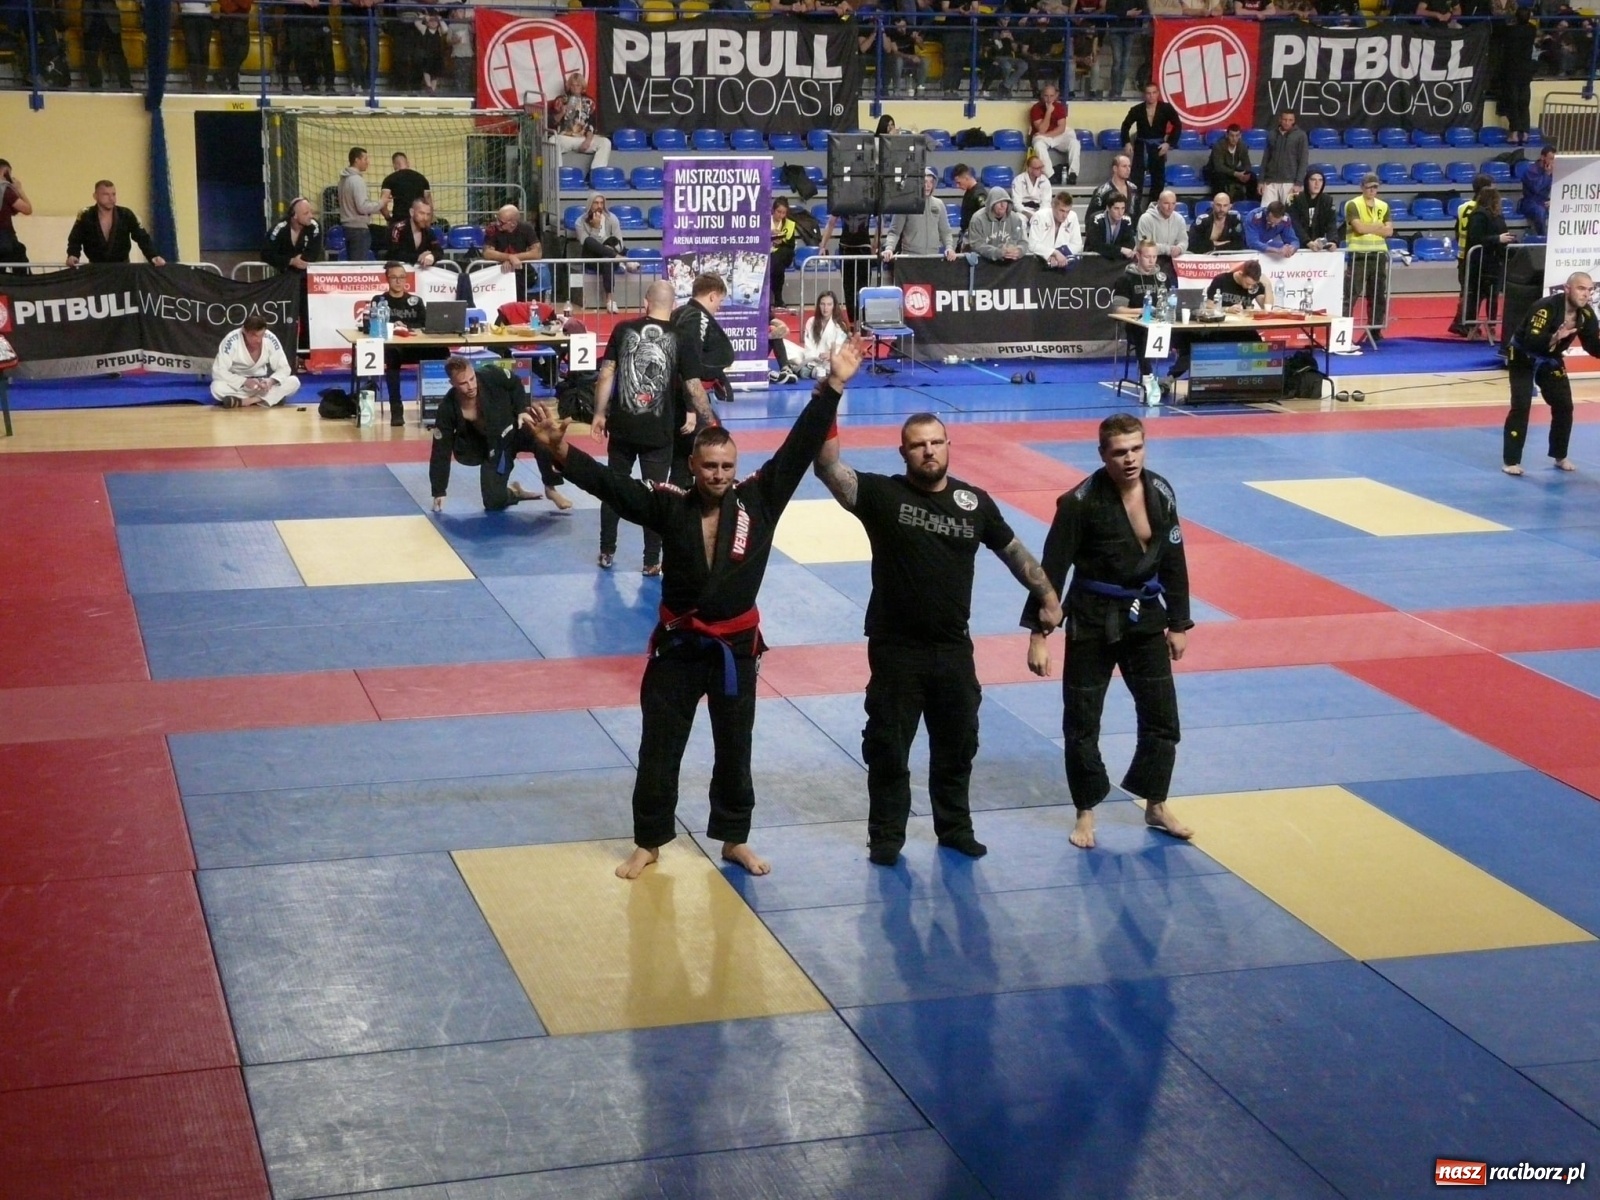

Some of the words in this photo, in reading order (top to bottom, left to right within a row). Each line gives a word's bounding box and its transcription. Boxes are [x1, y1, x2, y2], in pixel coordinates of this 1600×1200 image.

[612, 28, 843, 80] PITBULL
[1271, 34, 1474, 82] PITBULL
[231, 102, 245, 110] WC
[675, 168, 761, 184] MISTRZOSTWA
[674, 185, 761, 213] EUROPY
[1560, 203, 1592, 213] JU-JITSU
[673, 215, 725, 230] JU-JITSU
[731, 215, 747, 229] NO
[749, 214, 760, 229] GI
[1558, 220, 1600, 236] GLIWIC
[673, 236, 694, 245] ARENA
[694, 236, 719, 245] GLIWICE
[312, 275, 340, 284] NOWA
[340, 274, 380, 284] ODSŁONA
[429, 284, 447, 294] JUŻ
[14, 291, 140, 325] PITBULL
[935, 288, 1038, 312] PITBULL
[1152, 336, 1164, 352] 4
[1335, 330, 1346, 346] 4
[364, 352, 377, 370] 2
[577, 347, 590, 364] 2
[900, 503, 975, 529] PITBULL
[732, 509, 750, 555] VENUM
[898, 513, 975, 539] SPORTS
